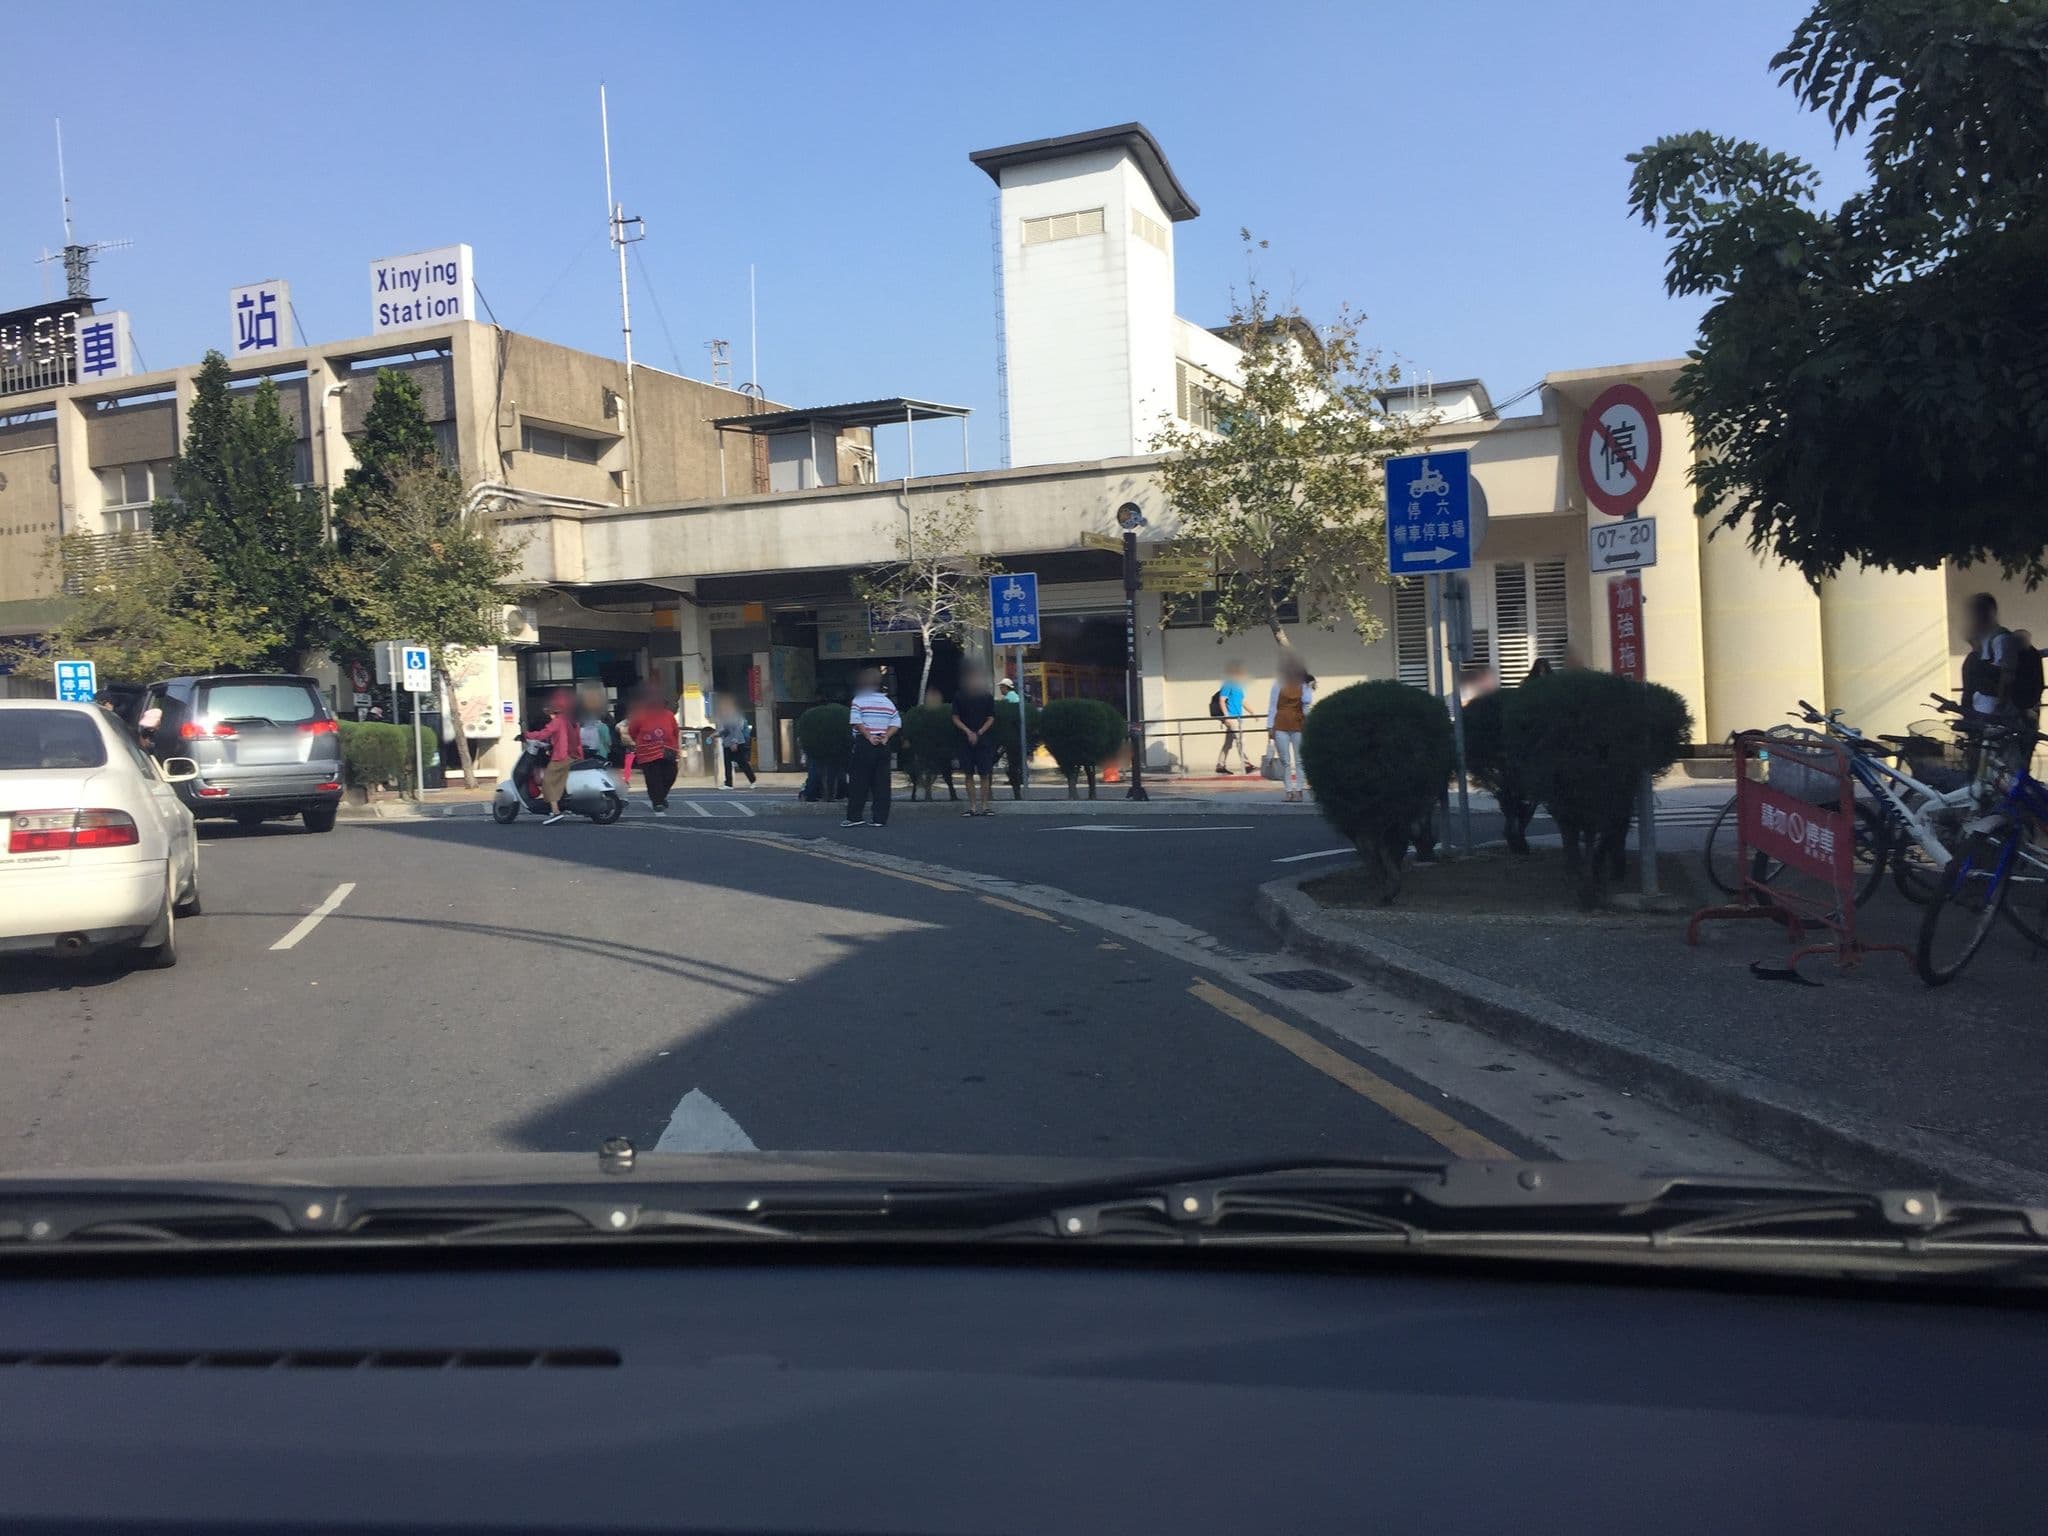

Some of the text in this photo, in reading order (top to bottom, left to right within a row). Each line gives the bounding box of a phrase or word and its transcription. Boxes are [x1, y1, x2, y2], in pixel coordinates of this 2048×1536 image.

[377, 261, 457, 293] Xinying
[82, 291, 277, 376] 車 站
[379, 296, 459, 326] Station
[1600, 421, 1637, 481] 停
